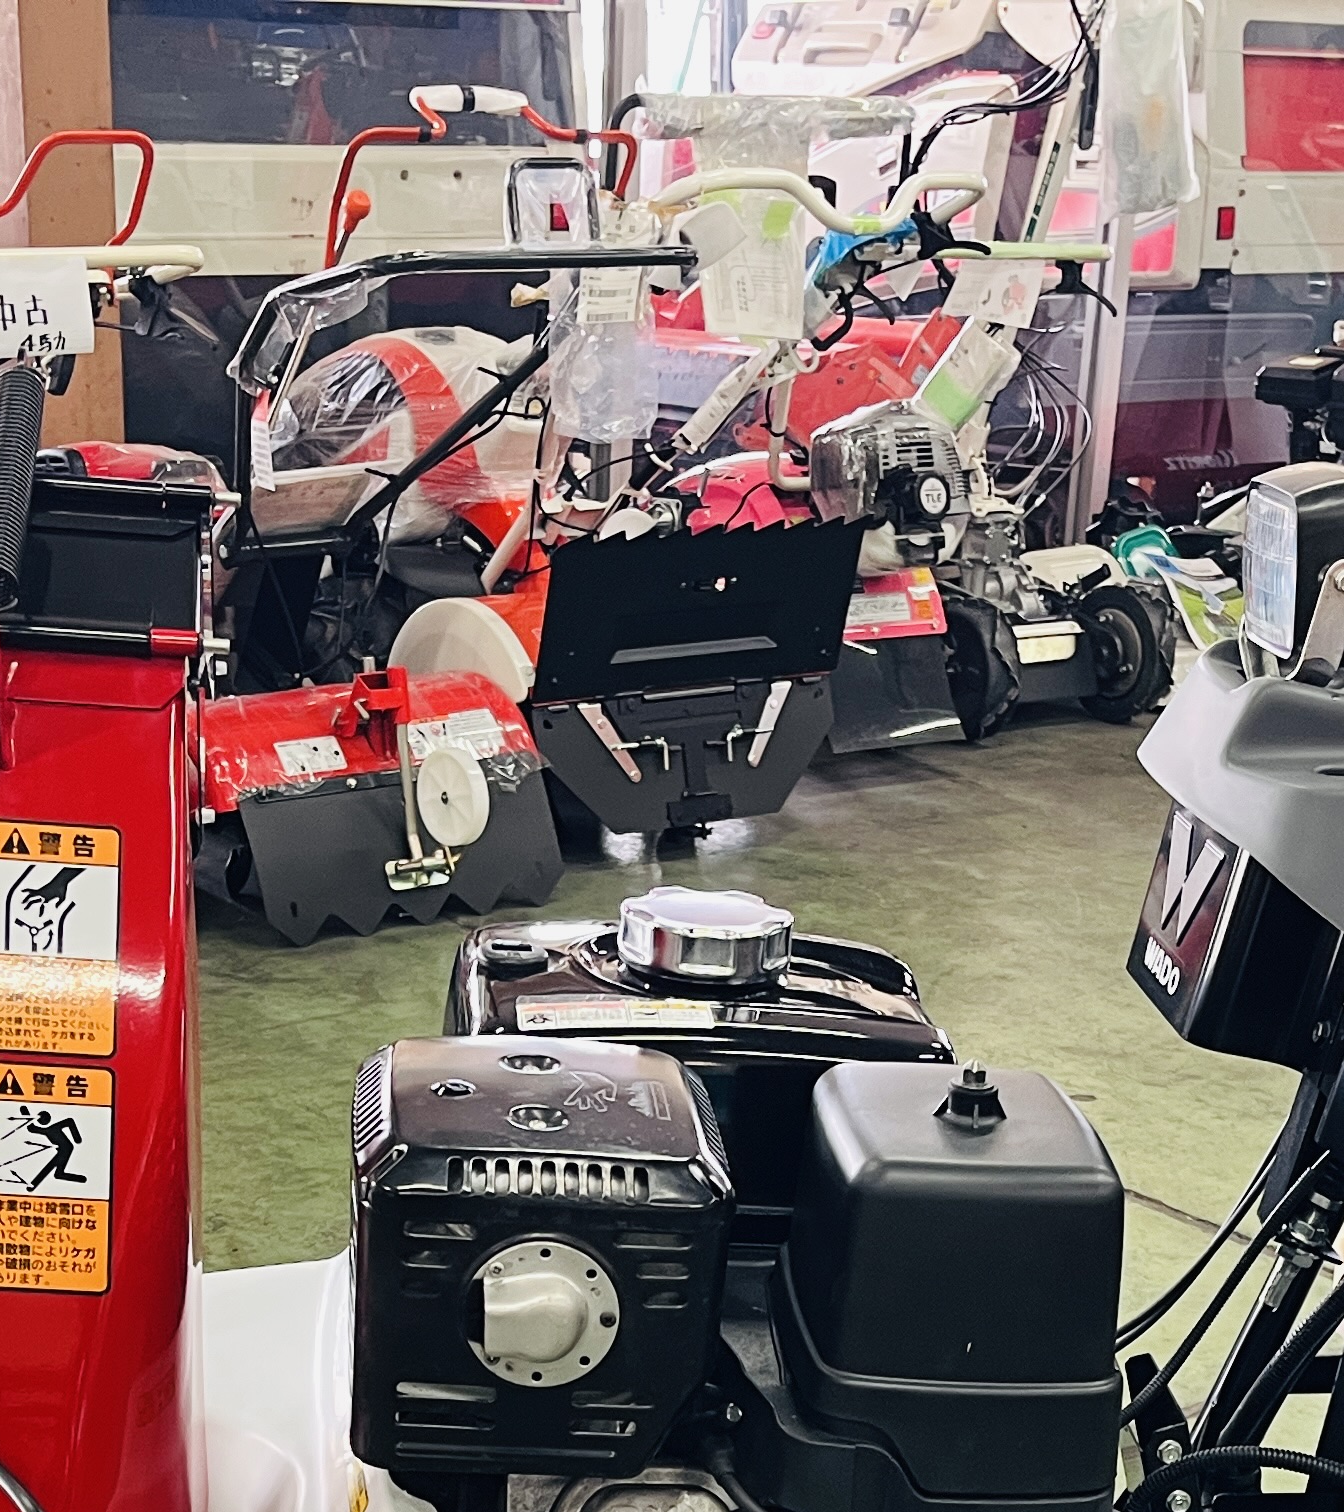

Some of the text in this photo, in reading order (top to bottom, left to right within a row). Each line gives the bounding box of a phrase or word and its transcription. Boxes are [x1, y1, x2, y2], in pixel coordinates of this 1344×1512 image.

[20, 330, 66, 352] 4馬力
[37, 830, 96, 858] 警告
[1143, 936, 1181, 997] WADO
[32, 1072, 89, 1098] 警告
